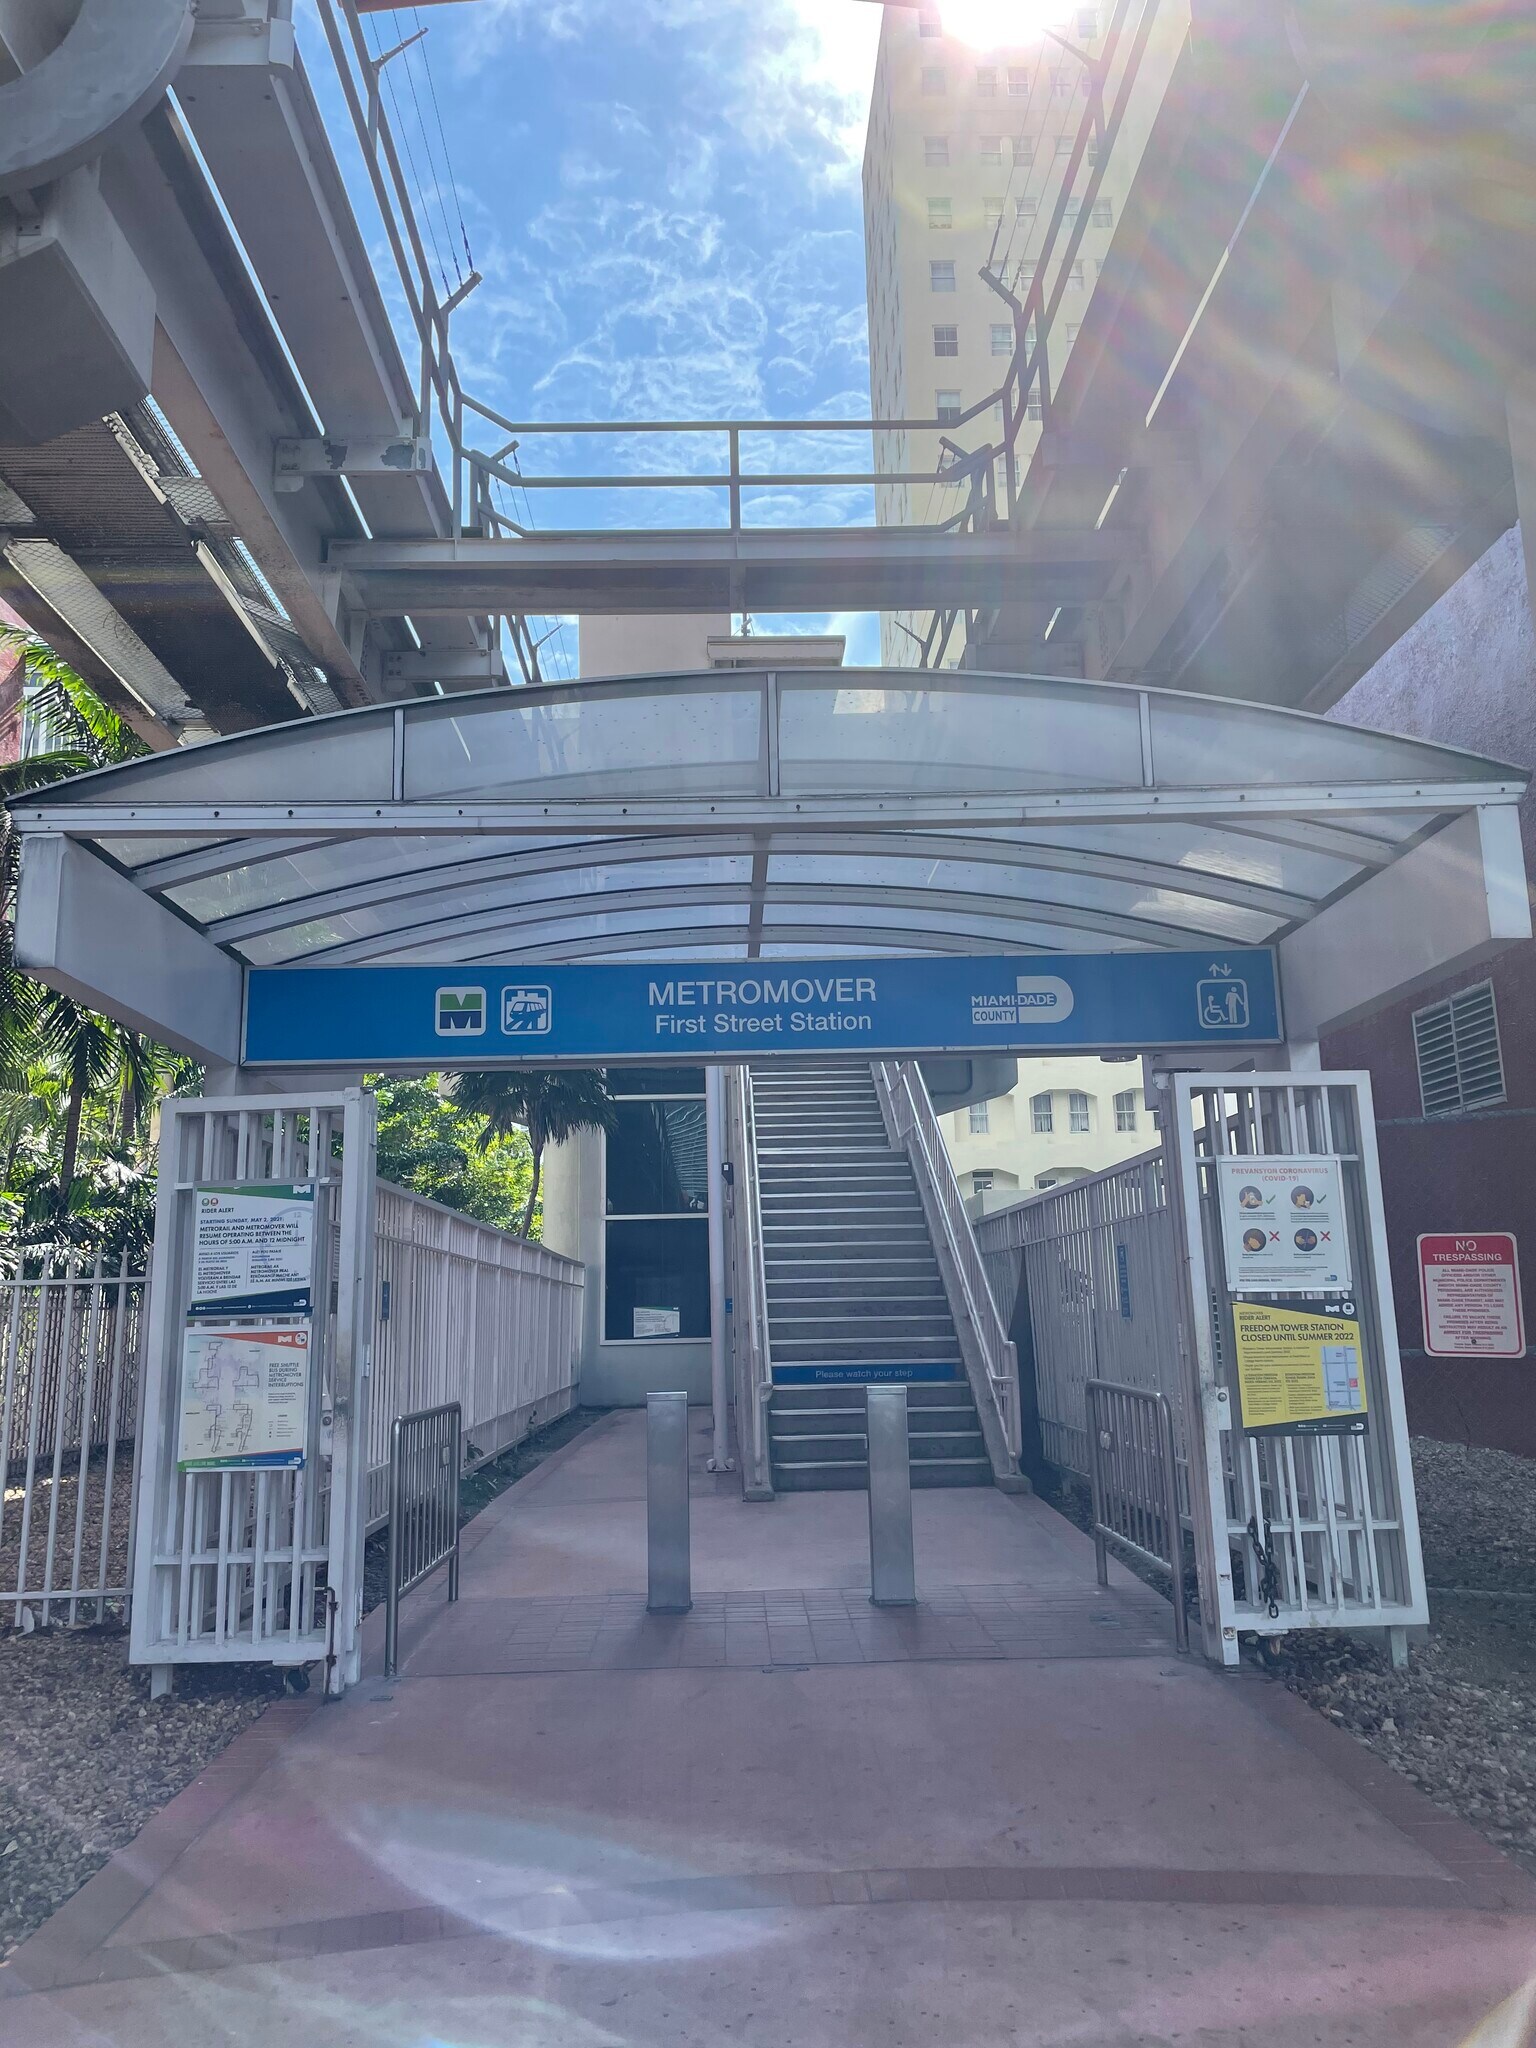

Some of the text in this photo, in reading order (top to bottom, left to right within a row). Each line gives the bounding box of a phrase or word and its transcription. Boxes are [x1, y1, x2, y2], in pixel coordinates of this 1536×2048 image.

[649, 978, 877, 1006] METROMOVER
[971, 994, 1055, 1007] MIAMI-DADE
[973, 1010, 1015, 1022] COUNTY
[656, 1011, 872, 1034] First Street Station
[1455, 1240, 1477, 1252] NO
[1433, 1253, 1502, 1262] TRESPASSING
[1240, 1323, 1344, 1332] FREEDOM TOWER STATION
[1241, 1332, 1354, 1342] CLOSED UNTIL SUMMER 2022
[815, 1369, 913, 1380] Please watch your step
